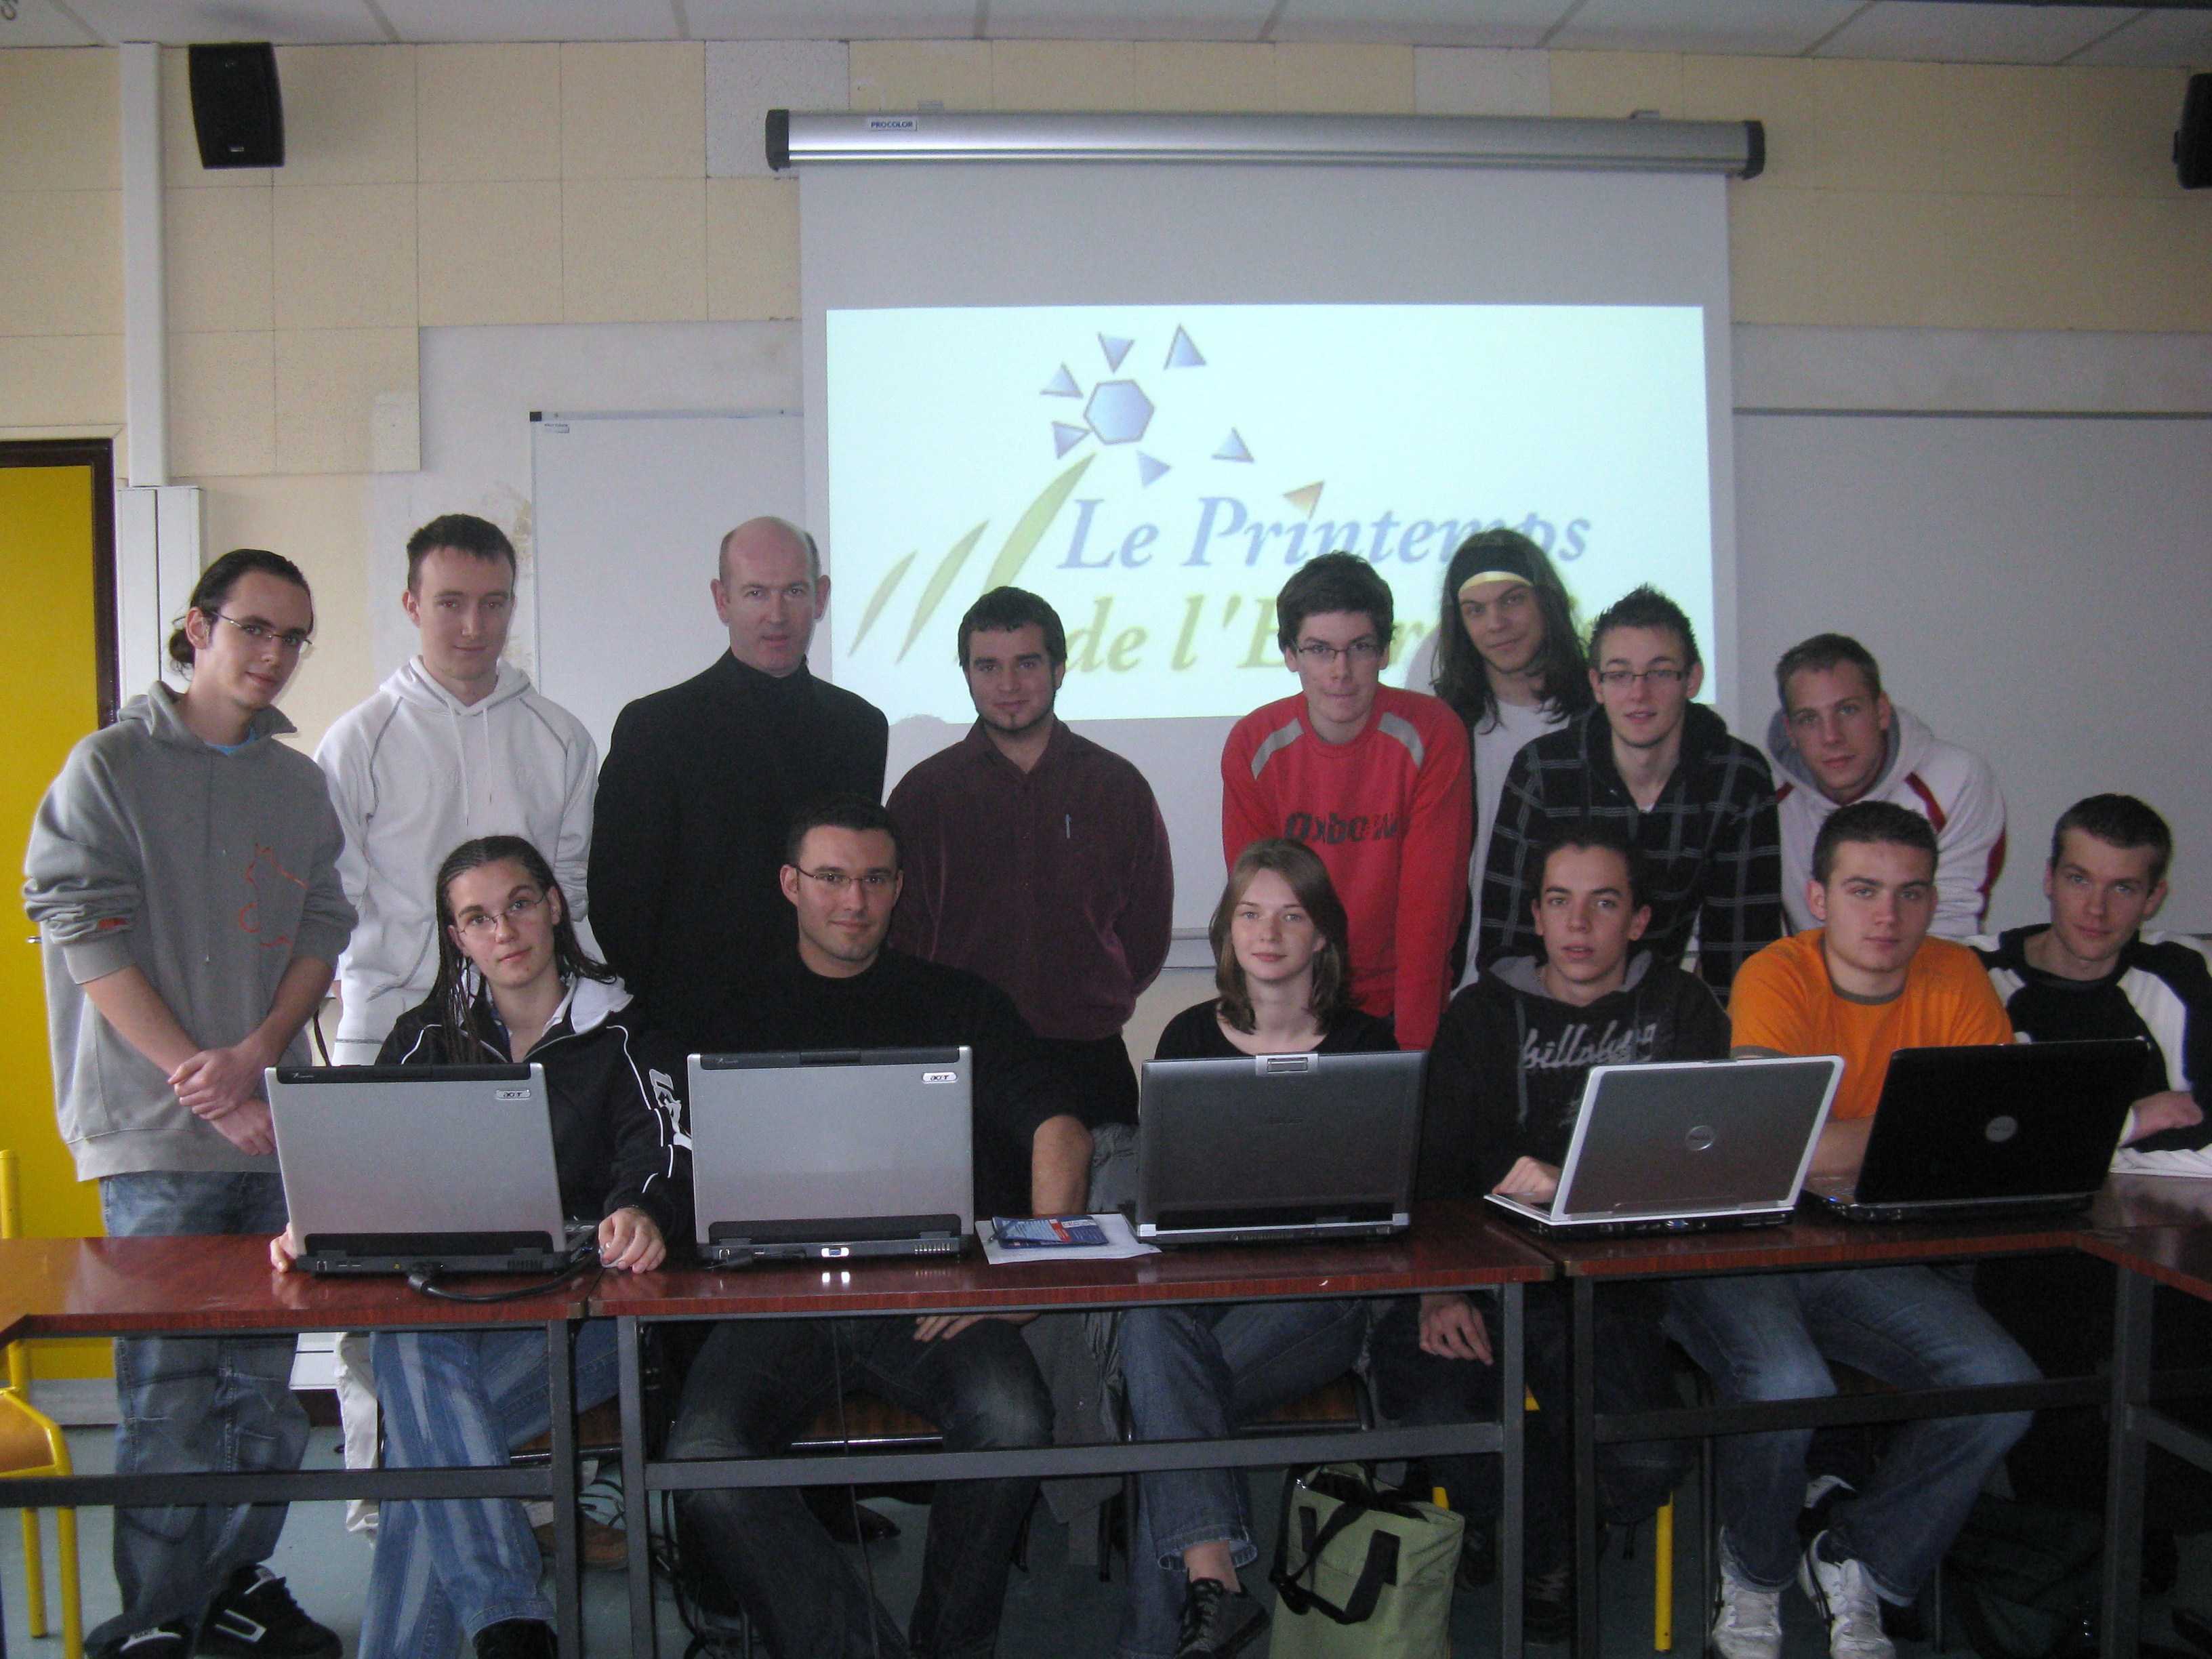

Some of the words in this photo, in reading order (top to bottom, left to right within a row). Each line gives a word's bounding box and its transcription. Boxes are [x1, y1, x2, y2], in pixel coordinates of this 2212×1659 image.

[870, 121, 914, 129] PROCOLOR
[1057, 497, 1160, 570] Le
[1065, 594, 1147, 673] de
